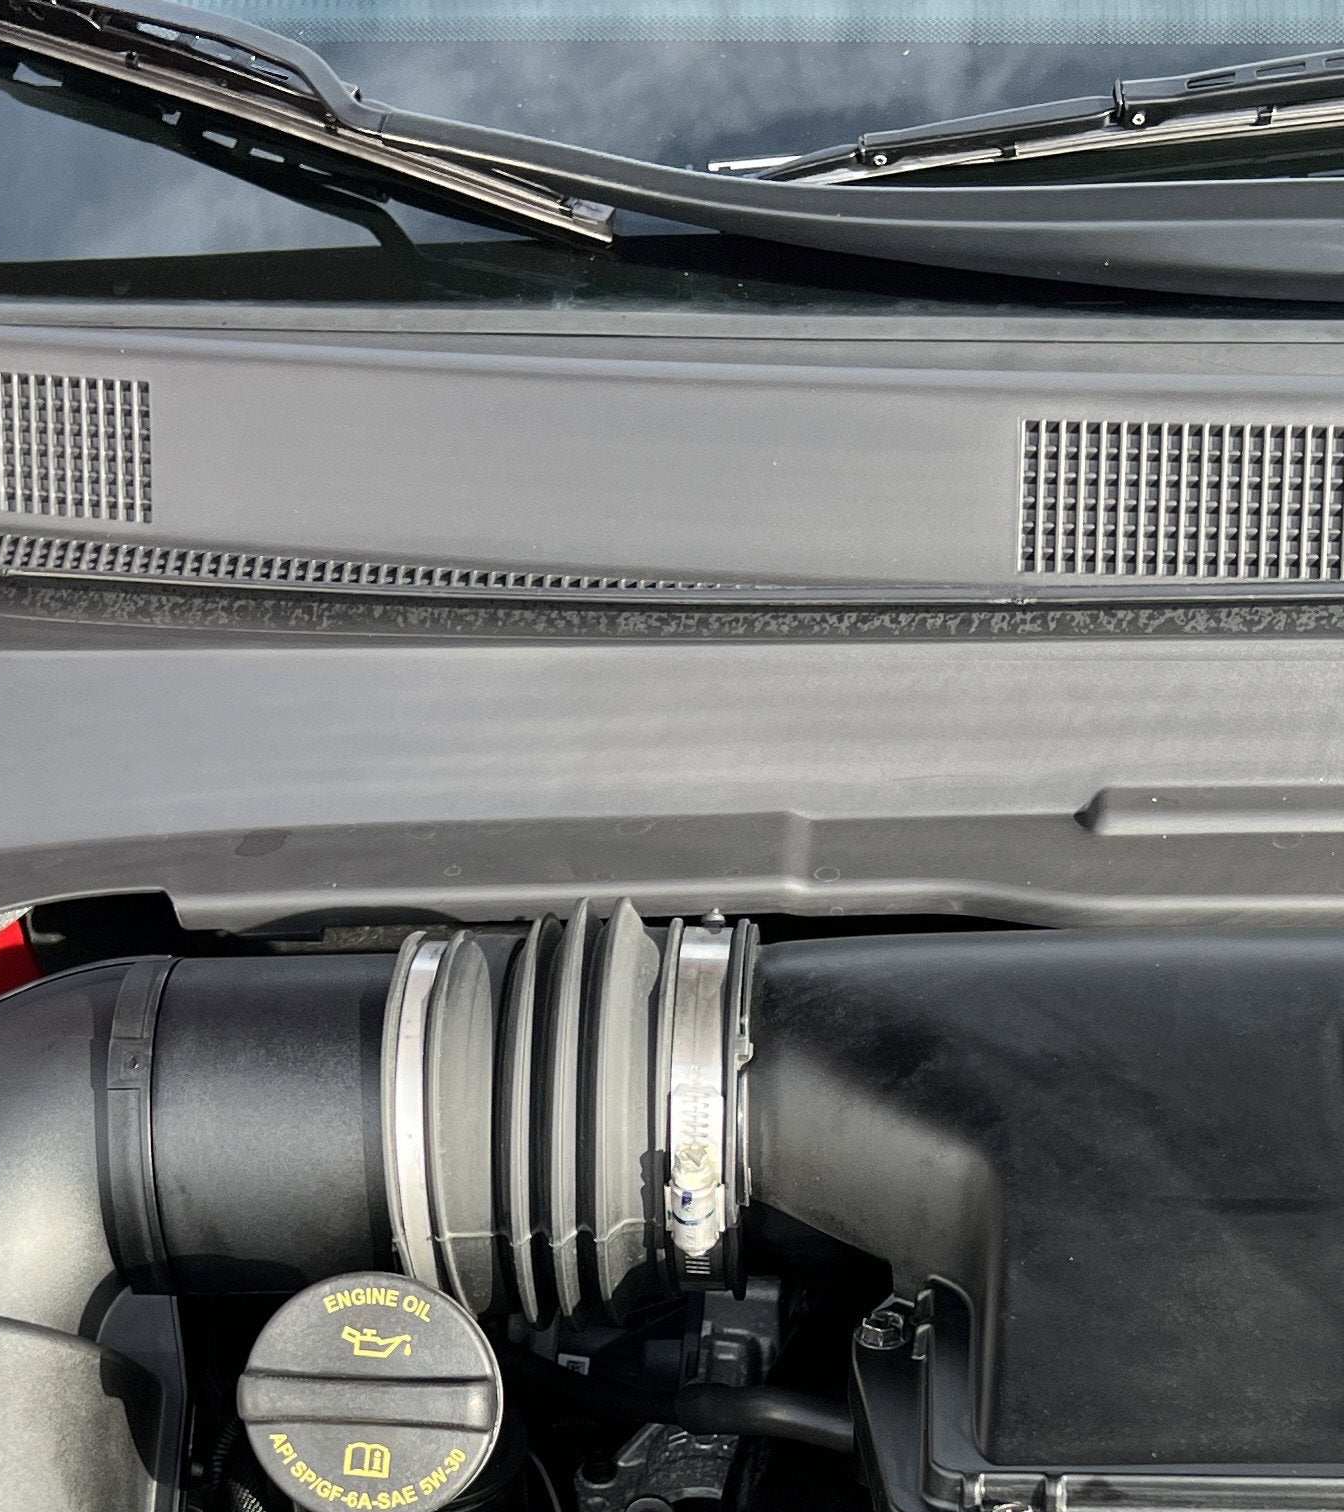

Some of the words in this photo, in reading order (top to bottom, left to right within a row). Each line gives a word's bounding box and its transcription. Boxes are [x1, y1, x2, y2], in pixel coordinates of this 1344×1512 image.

[323, 1288, 399, 1314] ENGINE
[402, 1295, 432, 1323] OIL
[269, 1433, 298, 1465] API
[290, 1460, 419, 1510] SP/GF-6A-SAE
[419, 1448, 467, 1496] 5W-30
